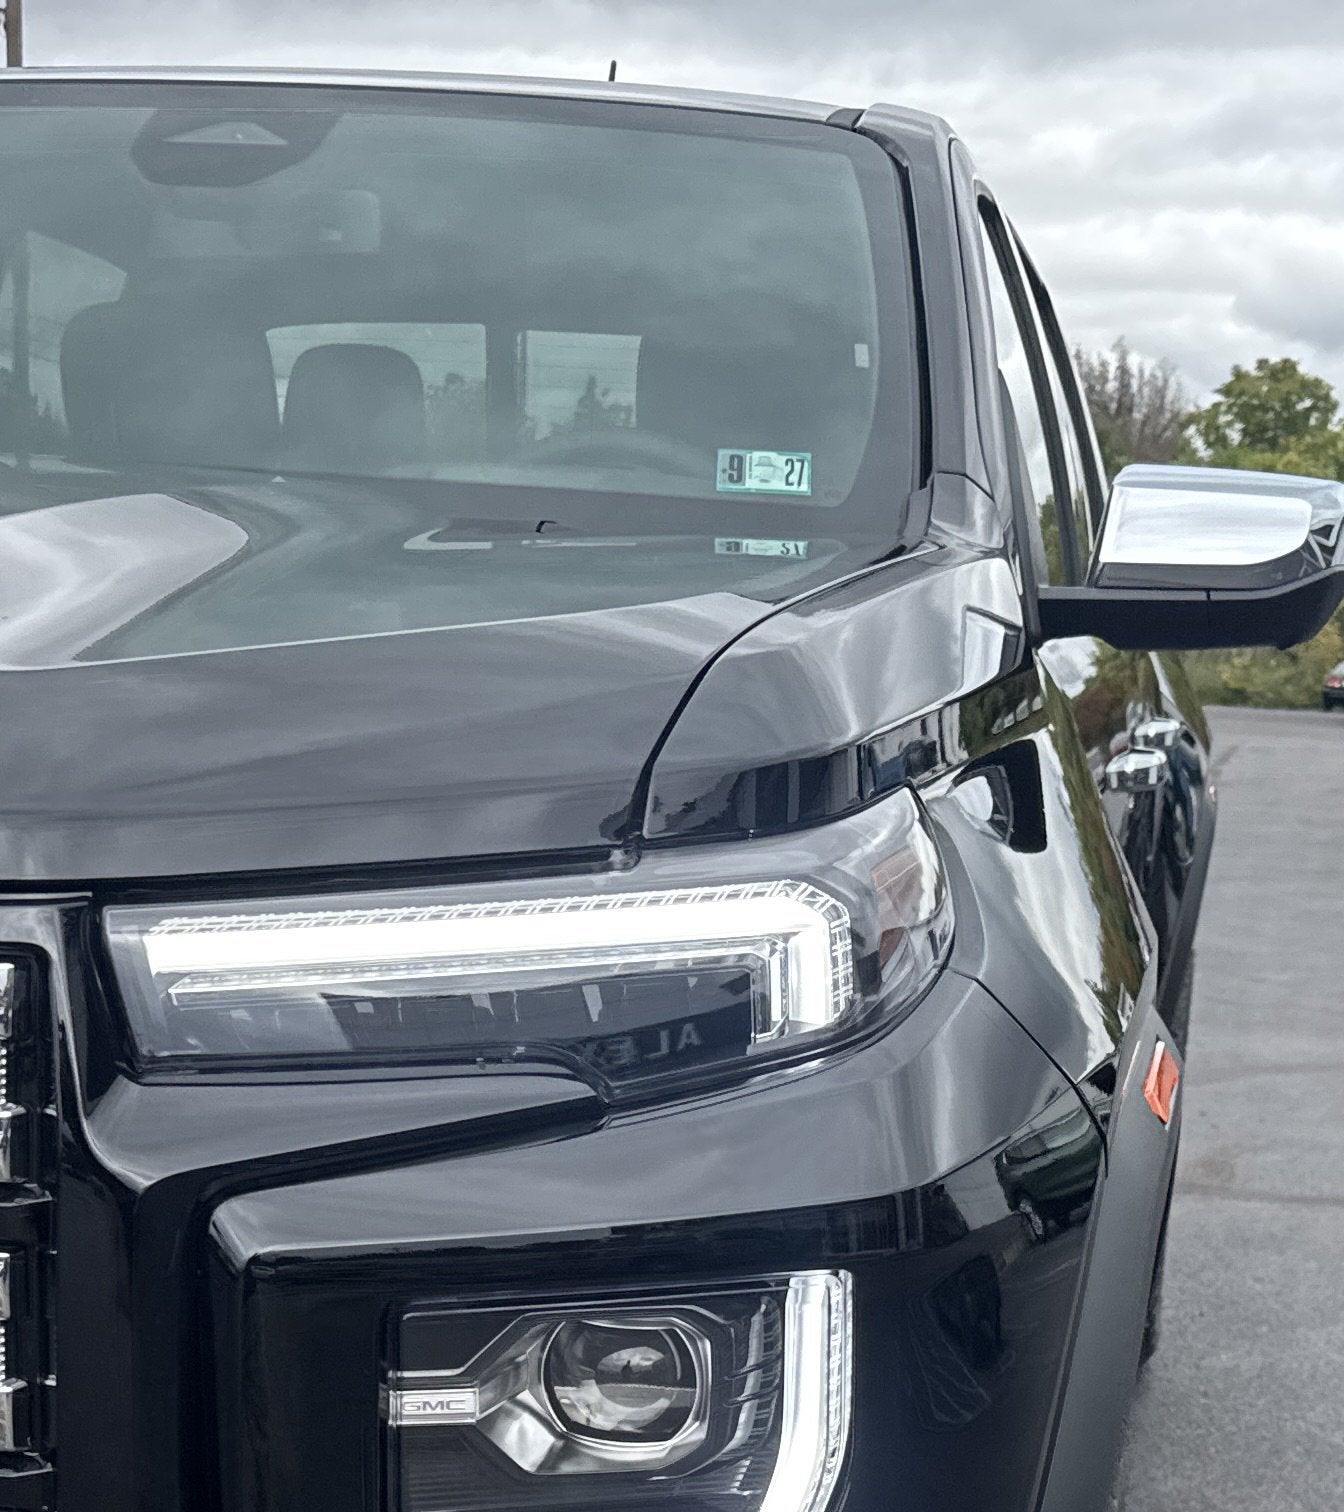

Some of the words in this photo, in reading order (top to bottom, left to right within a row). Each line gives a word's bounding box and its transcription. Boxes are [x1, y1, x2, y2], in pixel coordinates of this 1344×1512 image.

[728, 454, 744, 484] 9
[785, 458, 805, 488] 27
[402, 1399, 466, 1412] GMC
